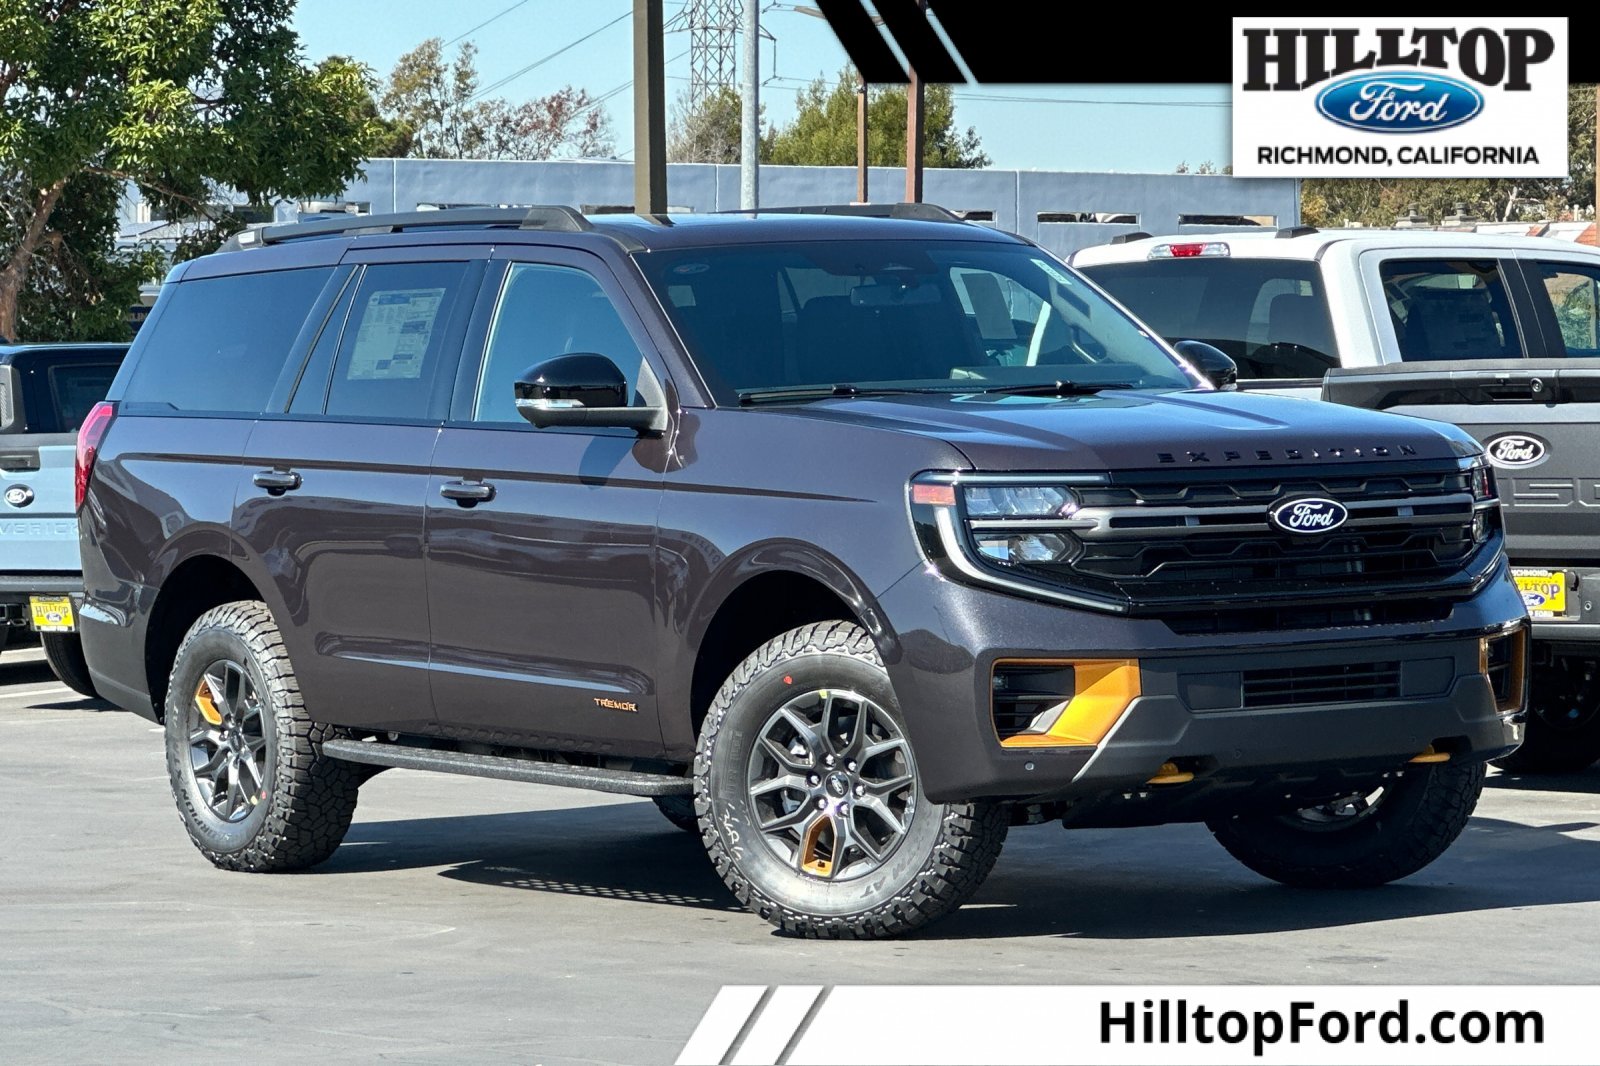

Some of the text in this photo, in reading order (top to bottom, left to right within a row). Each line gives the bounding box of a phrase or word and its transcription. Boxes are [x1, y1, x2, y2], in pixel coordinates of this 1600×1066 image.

[1157, 444, 1417, 463] EXPEDITION
[1495, 440, 1534, 459] Ford
[1289, 503, 1335, 528] Ford
[594, 697, 637, 712] TREMOR
